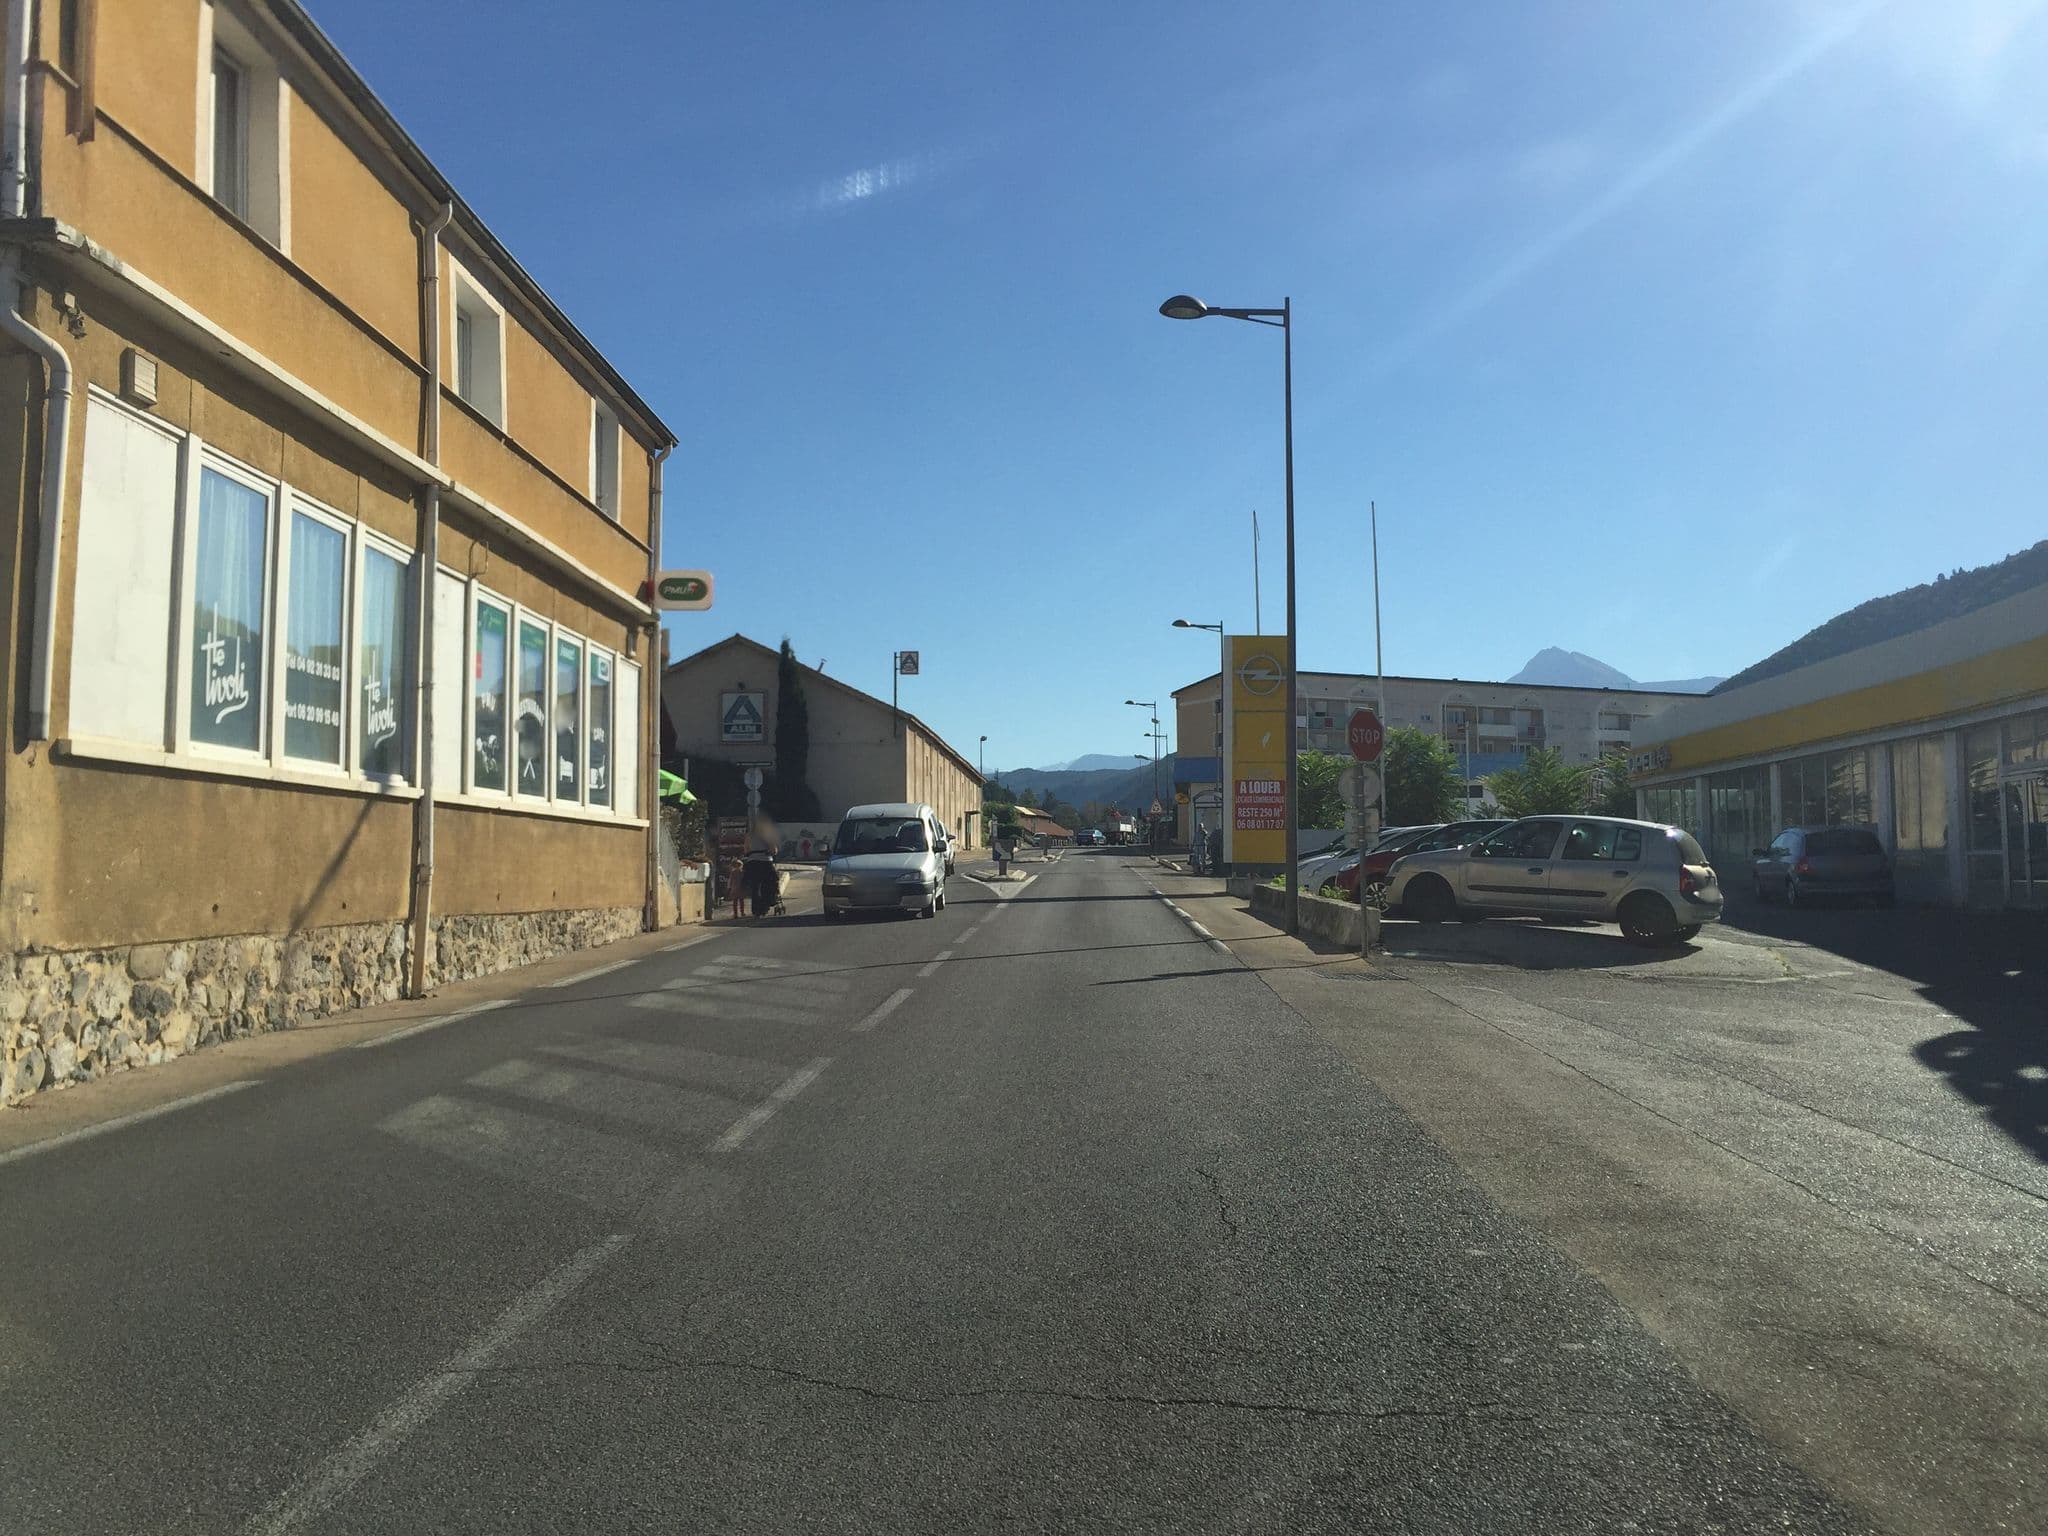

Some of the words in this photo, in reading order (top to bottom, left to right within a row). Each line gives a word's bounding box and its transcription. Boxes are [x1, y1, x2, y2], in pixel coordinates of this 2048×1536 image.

[730, 725, 756, 733] ALDI
[1352, 727, 1380, 744] STOP
[1240, 781, 1247, 794] A
[1248, 780, 1280, 794] LOUER
[1237, 807, 1259, 818] RESTE
